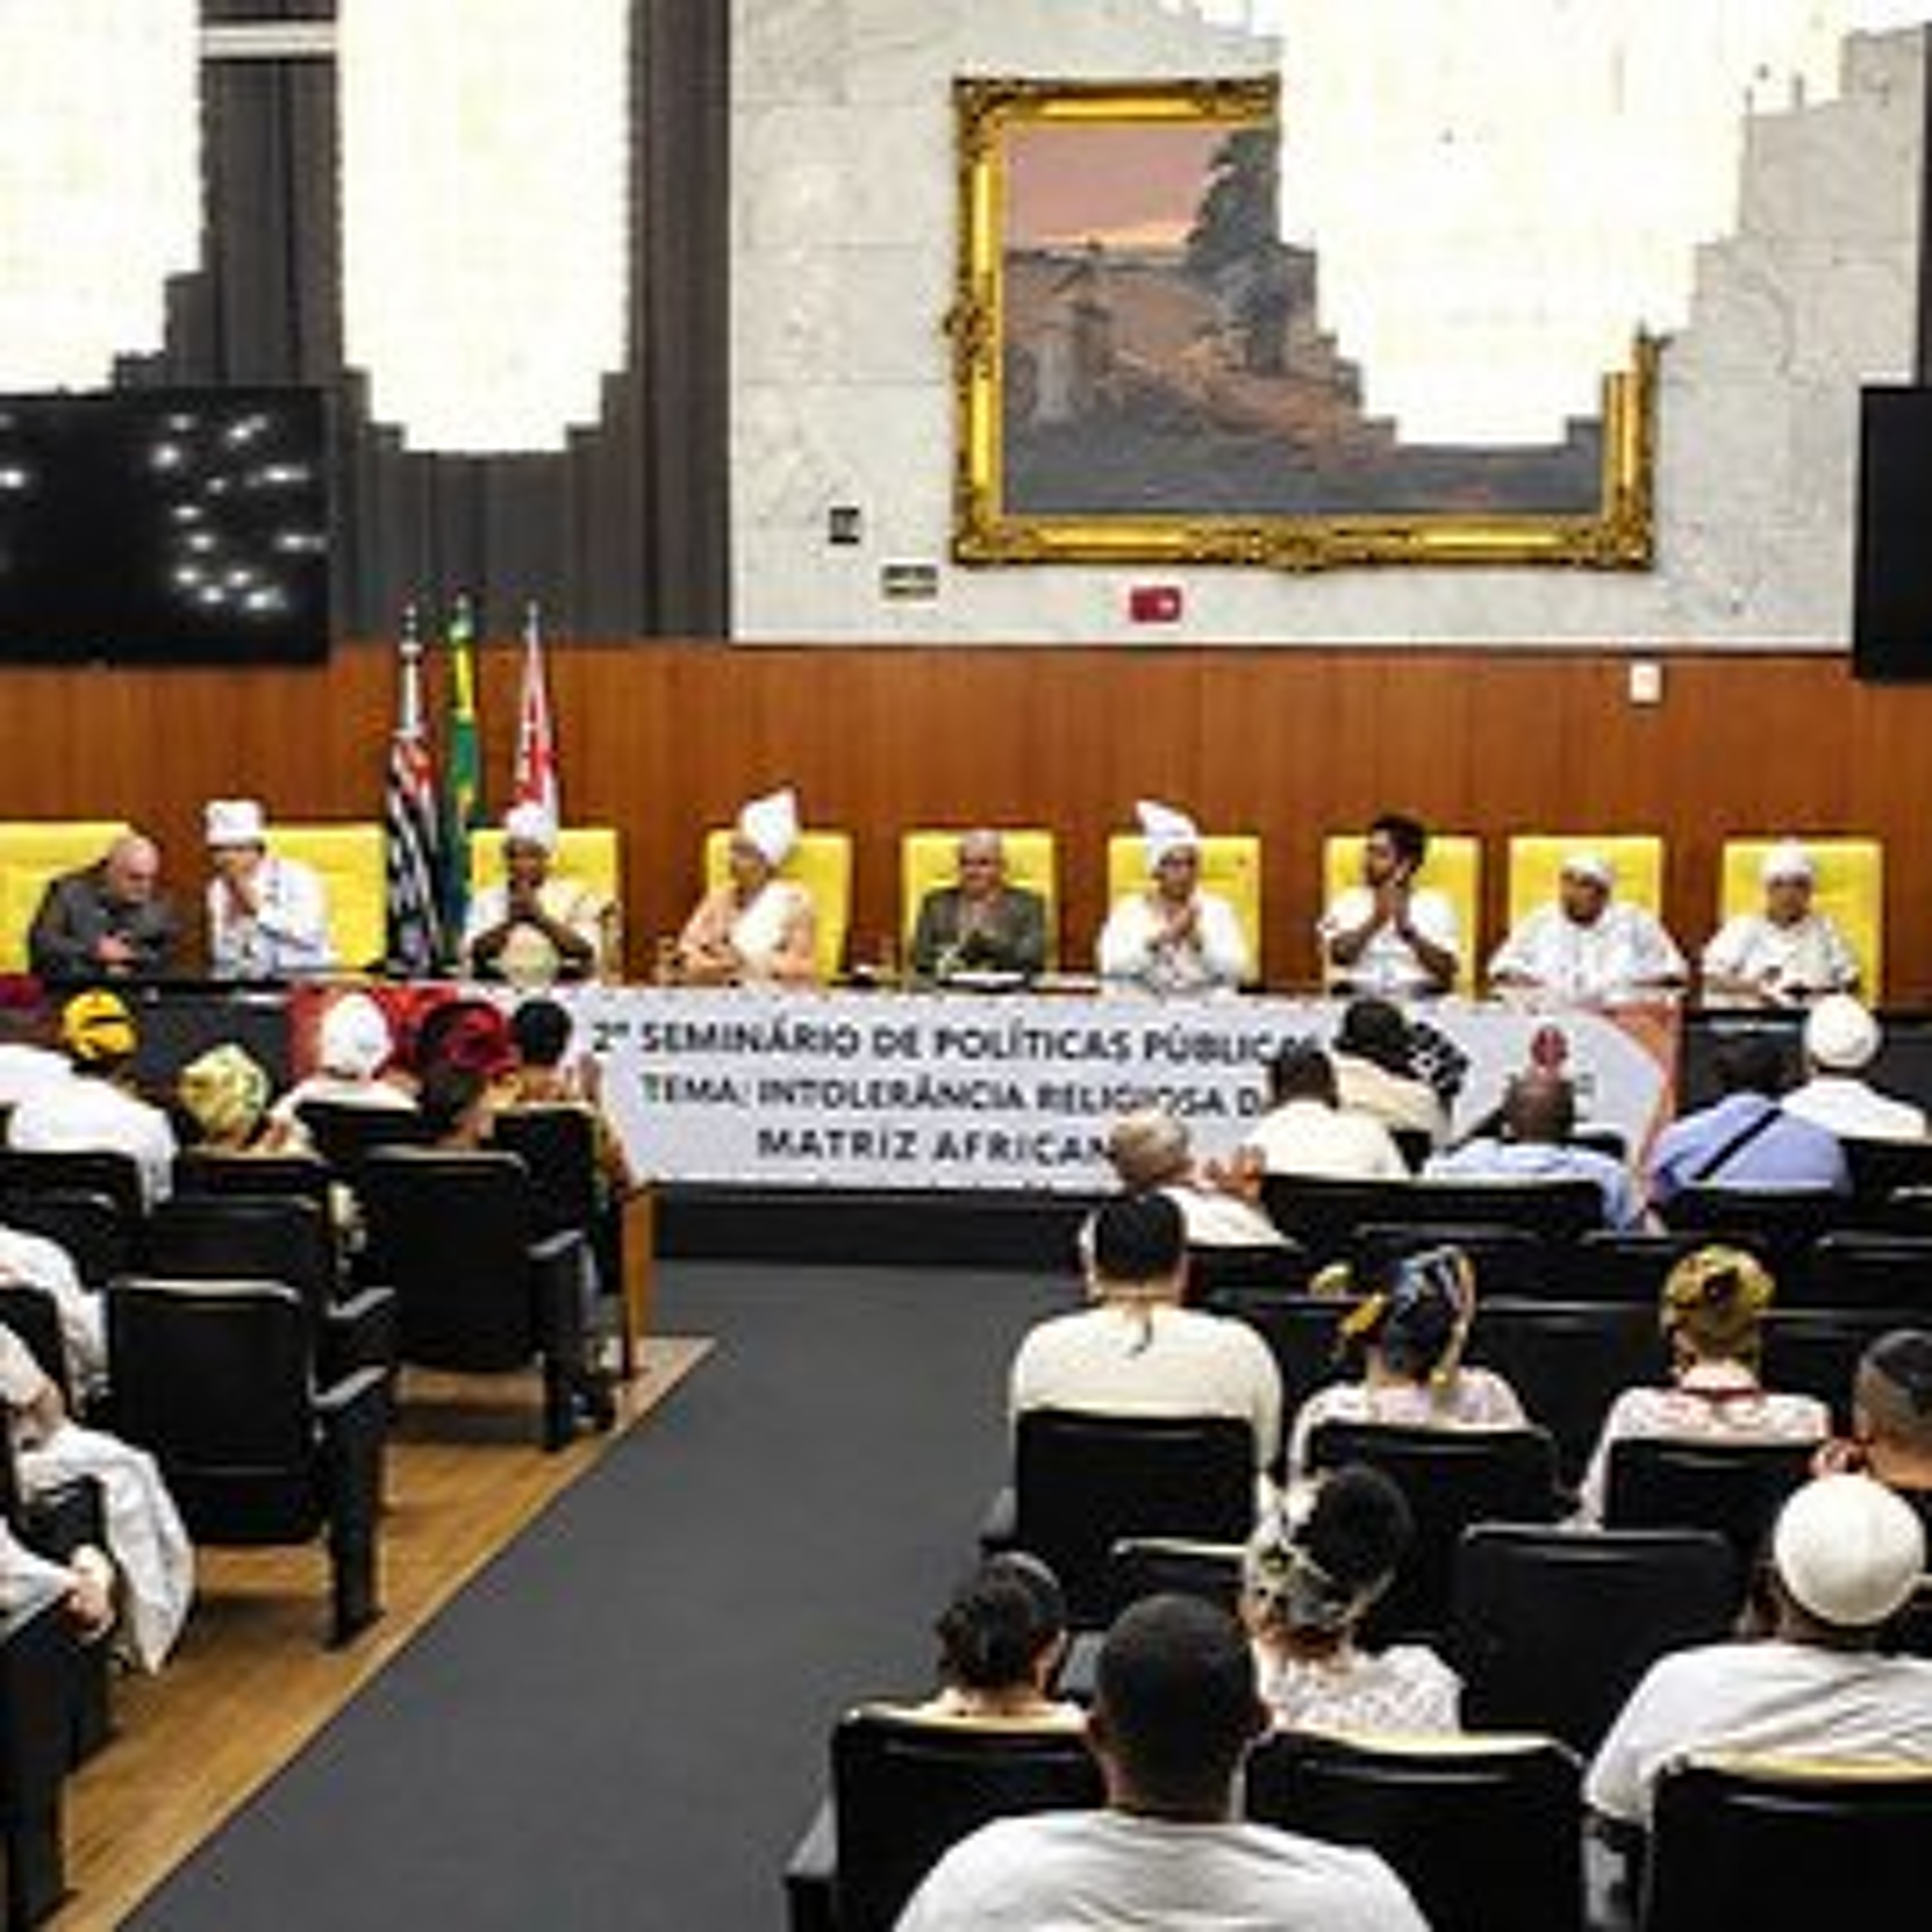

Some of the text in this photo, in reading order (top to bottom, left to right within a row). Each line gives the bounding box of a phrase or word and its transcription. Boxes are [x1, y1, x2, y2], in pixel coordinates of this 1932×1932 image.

[643, 1014, 859, 1058] SEMINÁRIO
[872, 1024, 920, 1058] DE
[935, 1018, 1130, 1064] POLÍTICAS
[759, 1075, 1025, 1110] INTOLERÂNCIA
[758, 1126, 916, 1160] MATRIZ
